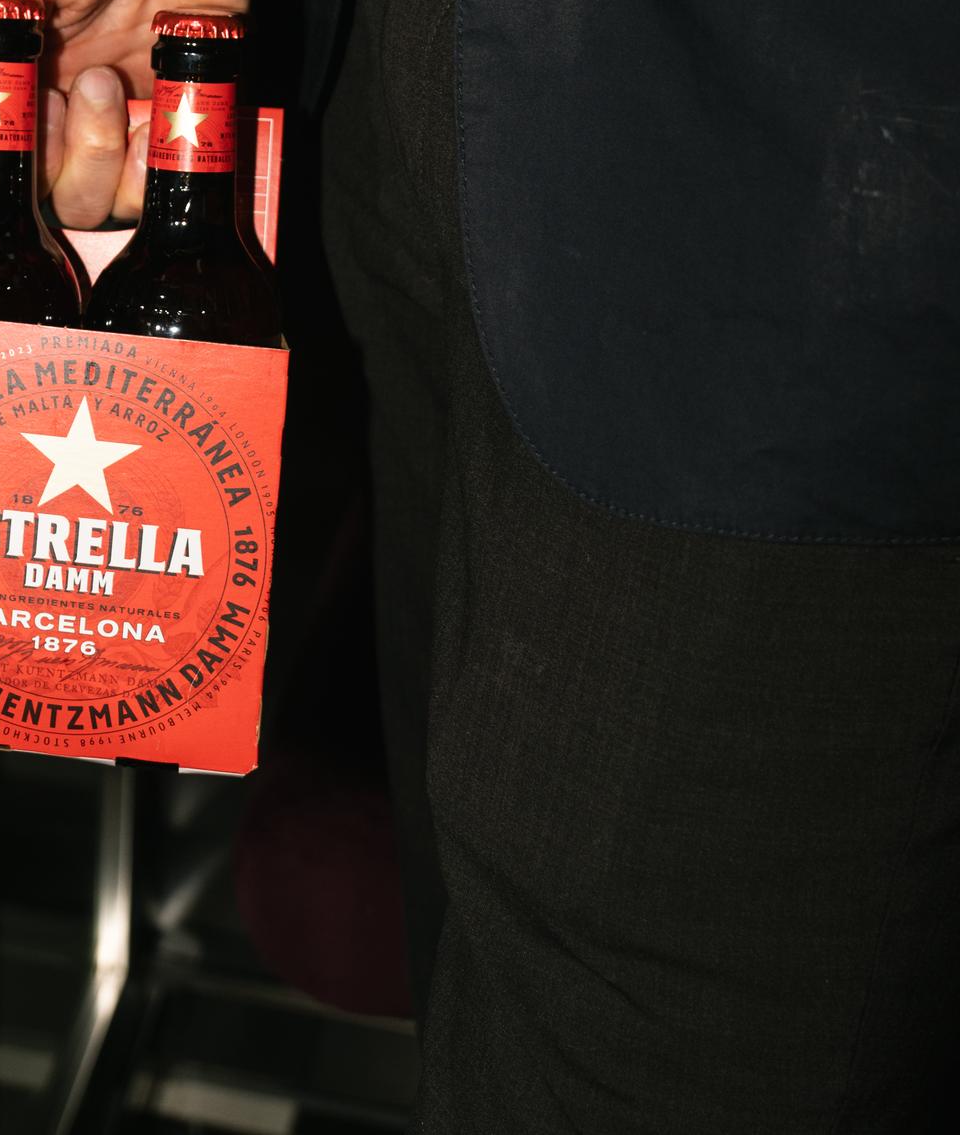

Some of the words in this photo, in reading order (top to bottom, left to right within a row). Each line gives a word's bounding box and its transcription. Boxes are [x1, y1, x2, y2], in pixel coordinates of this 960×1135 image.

[0, 343, 34, 361] 2023
[41, 335, 138, 360] PREMIADA
[144, 356, 196, 392] VIENNA
[11, 394, 74, 419] MALTA
[95, 398, 104, 412] Y
[108, 402, 171, 444] ARROZ
[34, 359, 252, 508] MEDITERRÁNEA
[229, 422, 266, 479] LONDON
[260, 483, 276, 517] 1905
[12, 493, 35, 505] 18
[118, 504, 143, 517] 76
[232, 525, 259, 588] 1876
[23, 562, 116, 596] DAMM
[99, 604, 181, 621] NATURALES
[31, 634, 97, 656] 1876
[178, 600, 252, 689] DAMM
[231, 629, 262, 671] PARIS
[205, 672, 232, 700] 1964
[119, 701, 202, 745] MELBOURNE
[79, 735, 112, 748] 1998
